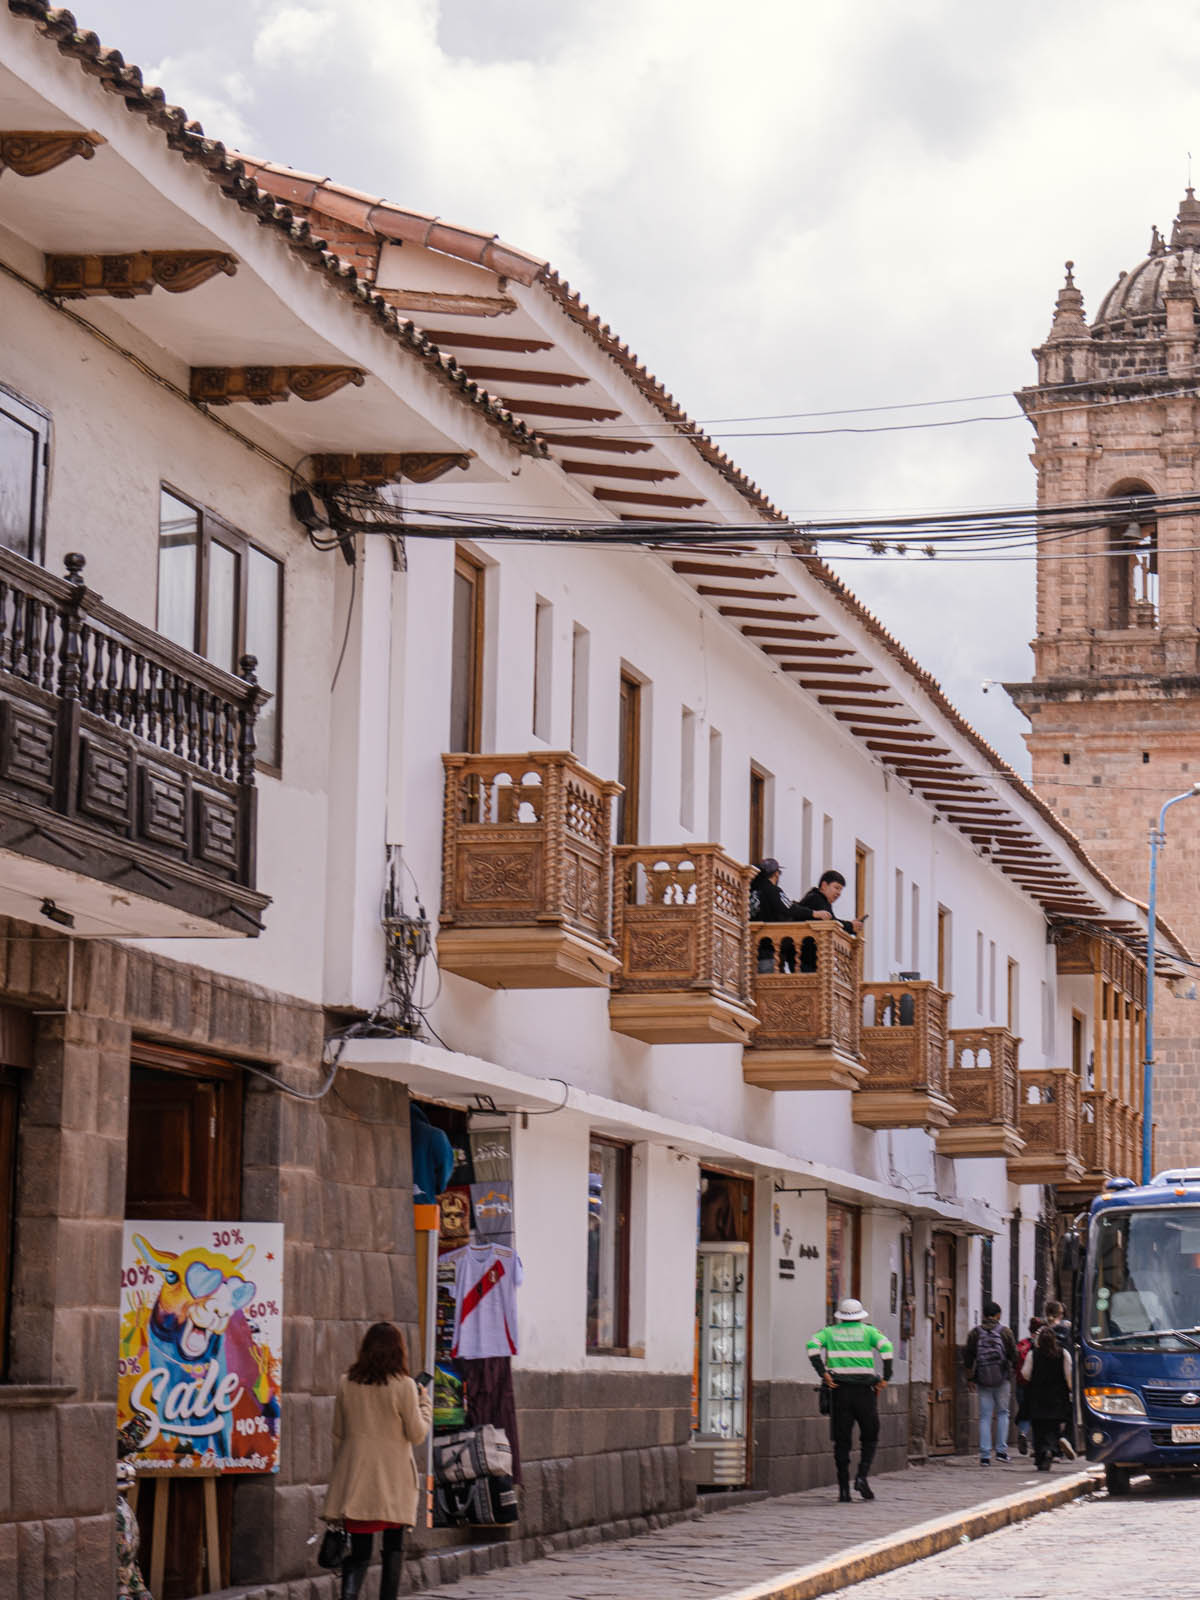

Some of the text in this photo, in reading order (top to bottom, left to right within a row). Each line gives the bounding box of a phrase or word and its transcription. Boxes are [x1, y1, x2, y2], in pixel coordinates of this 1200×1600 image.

[212, 1229, 244, 1248] 30%
[249, 1300, 279, 1318] 60%
[128, 1359, 244, 1449] Sale
[236, 1416, 269, 1435] 40%
